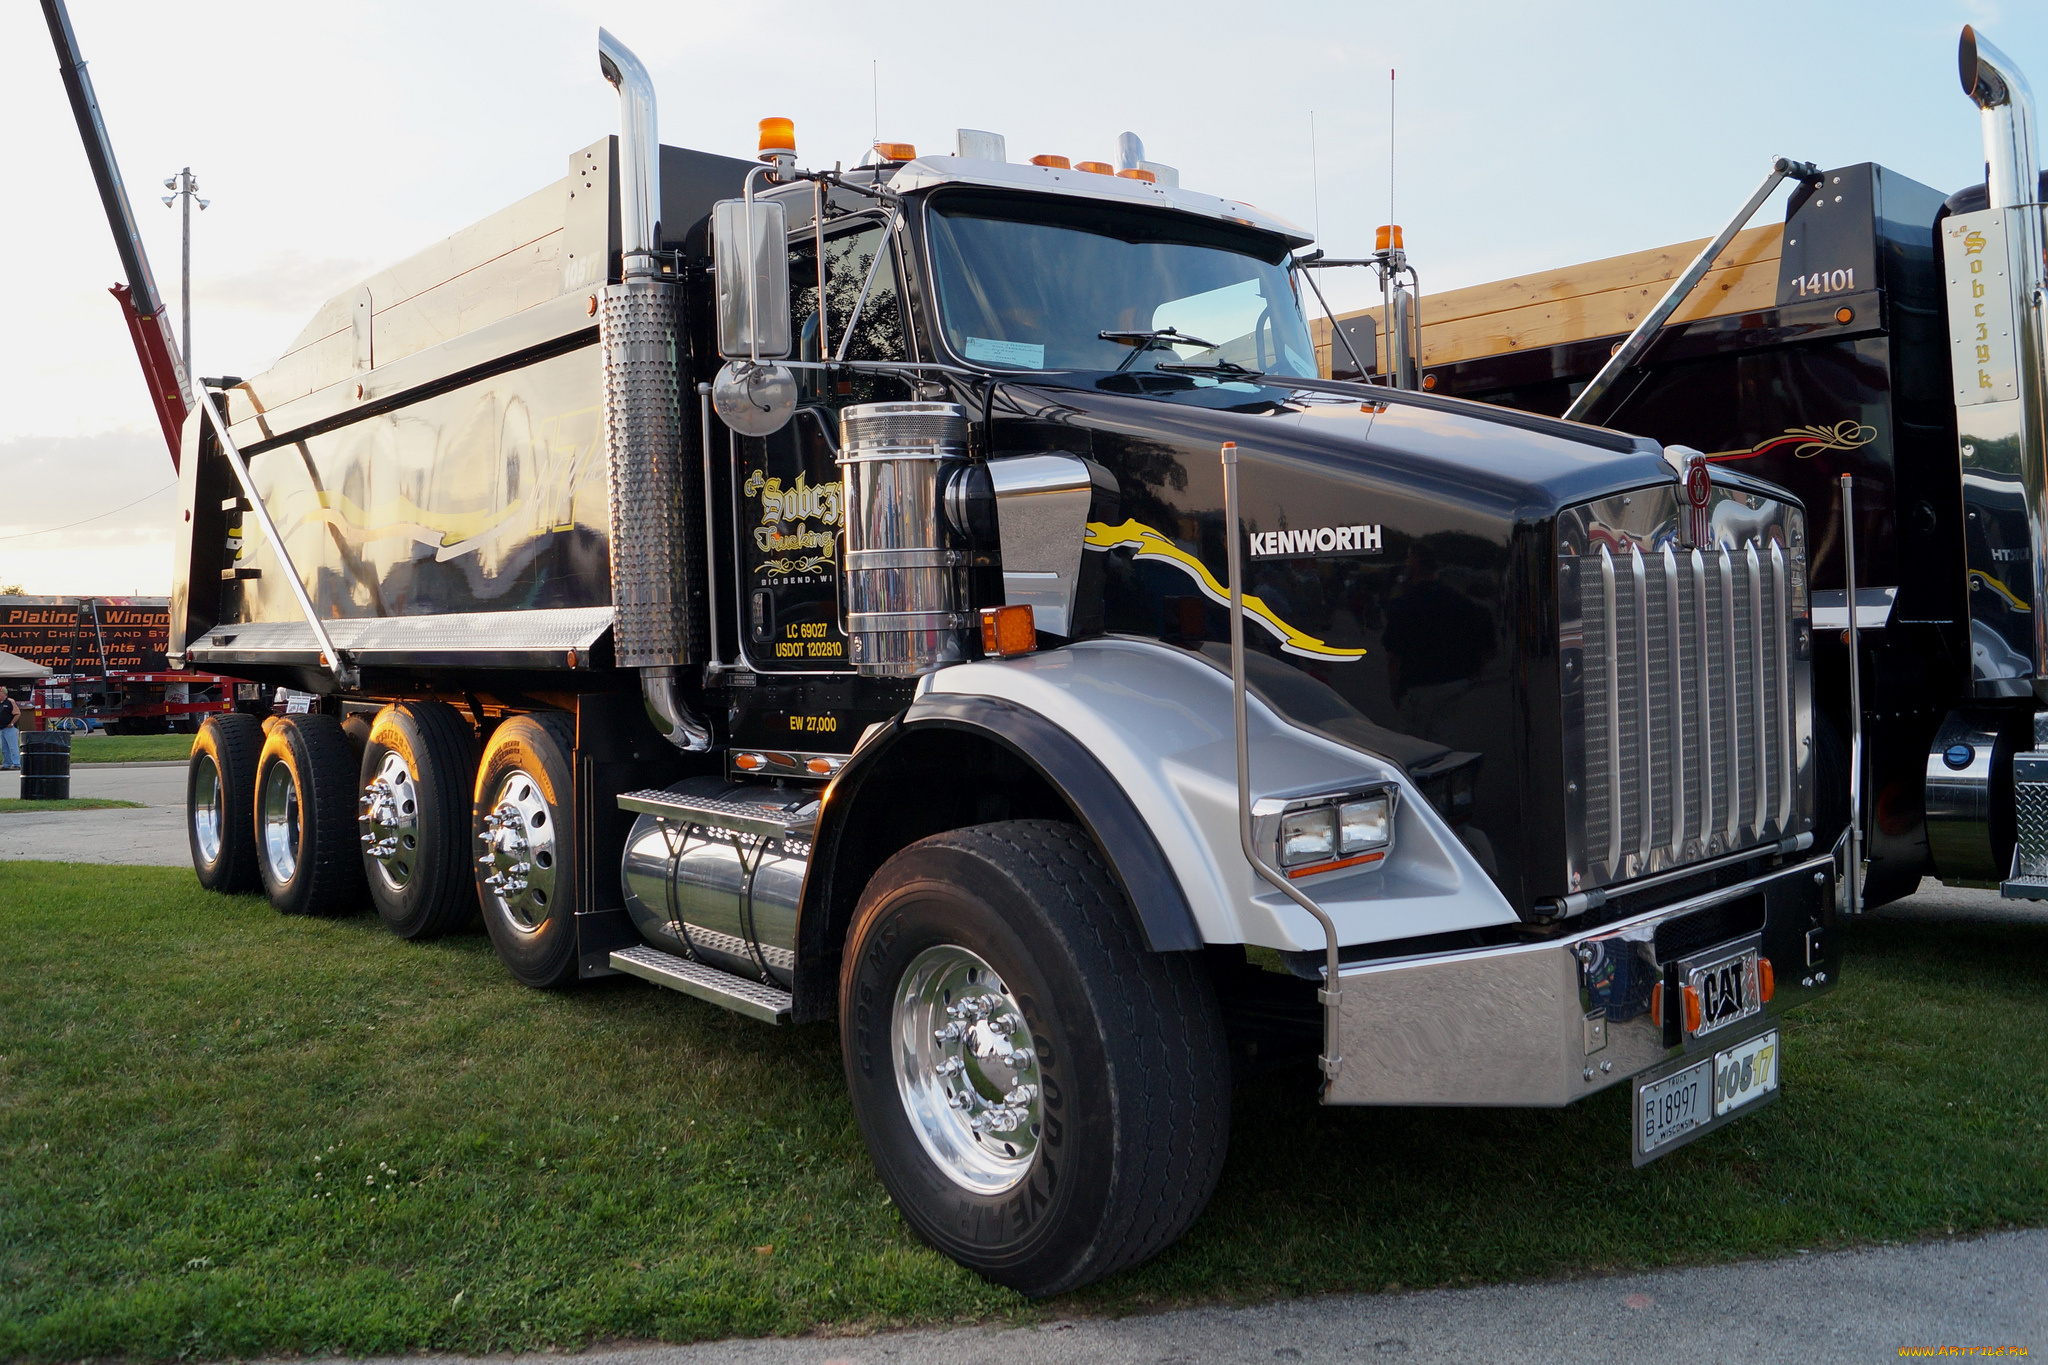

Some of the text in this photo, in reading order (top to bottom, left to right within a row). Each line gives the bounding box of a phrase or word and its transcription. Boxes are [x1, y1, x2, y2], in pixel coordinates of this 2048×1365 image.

[1797, 267, 1855, 297] 14101
[754, 522, 835, 557] Trucking
[1250, 524, 1382, 556] KENWORTH
[761, 574, 833, 586] BIG BEND, WI
[786, 623, 828, 639] LC 69027
[775, 641, 842, 657] USDOT 1202810
[789, 716, 837, 733] EW 27,000
[1703, 962, 1744, 1023] CAT
[1668, 1075, 1687, 1089] TRUCK
[1657, 1082, 1697, 1130] 18997
[1660, 1117, 1695, 1141] WISCONSIN
